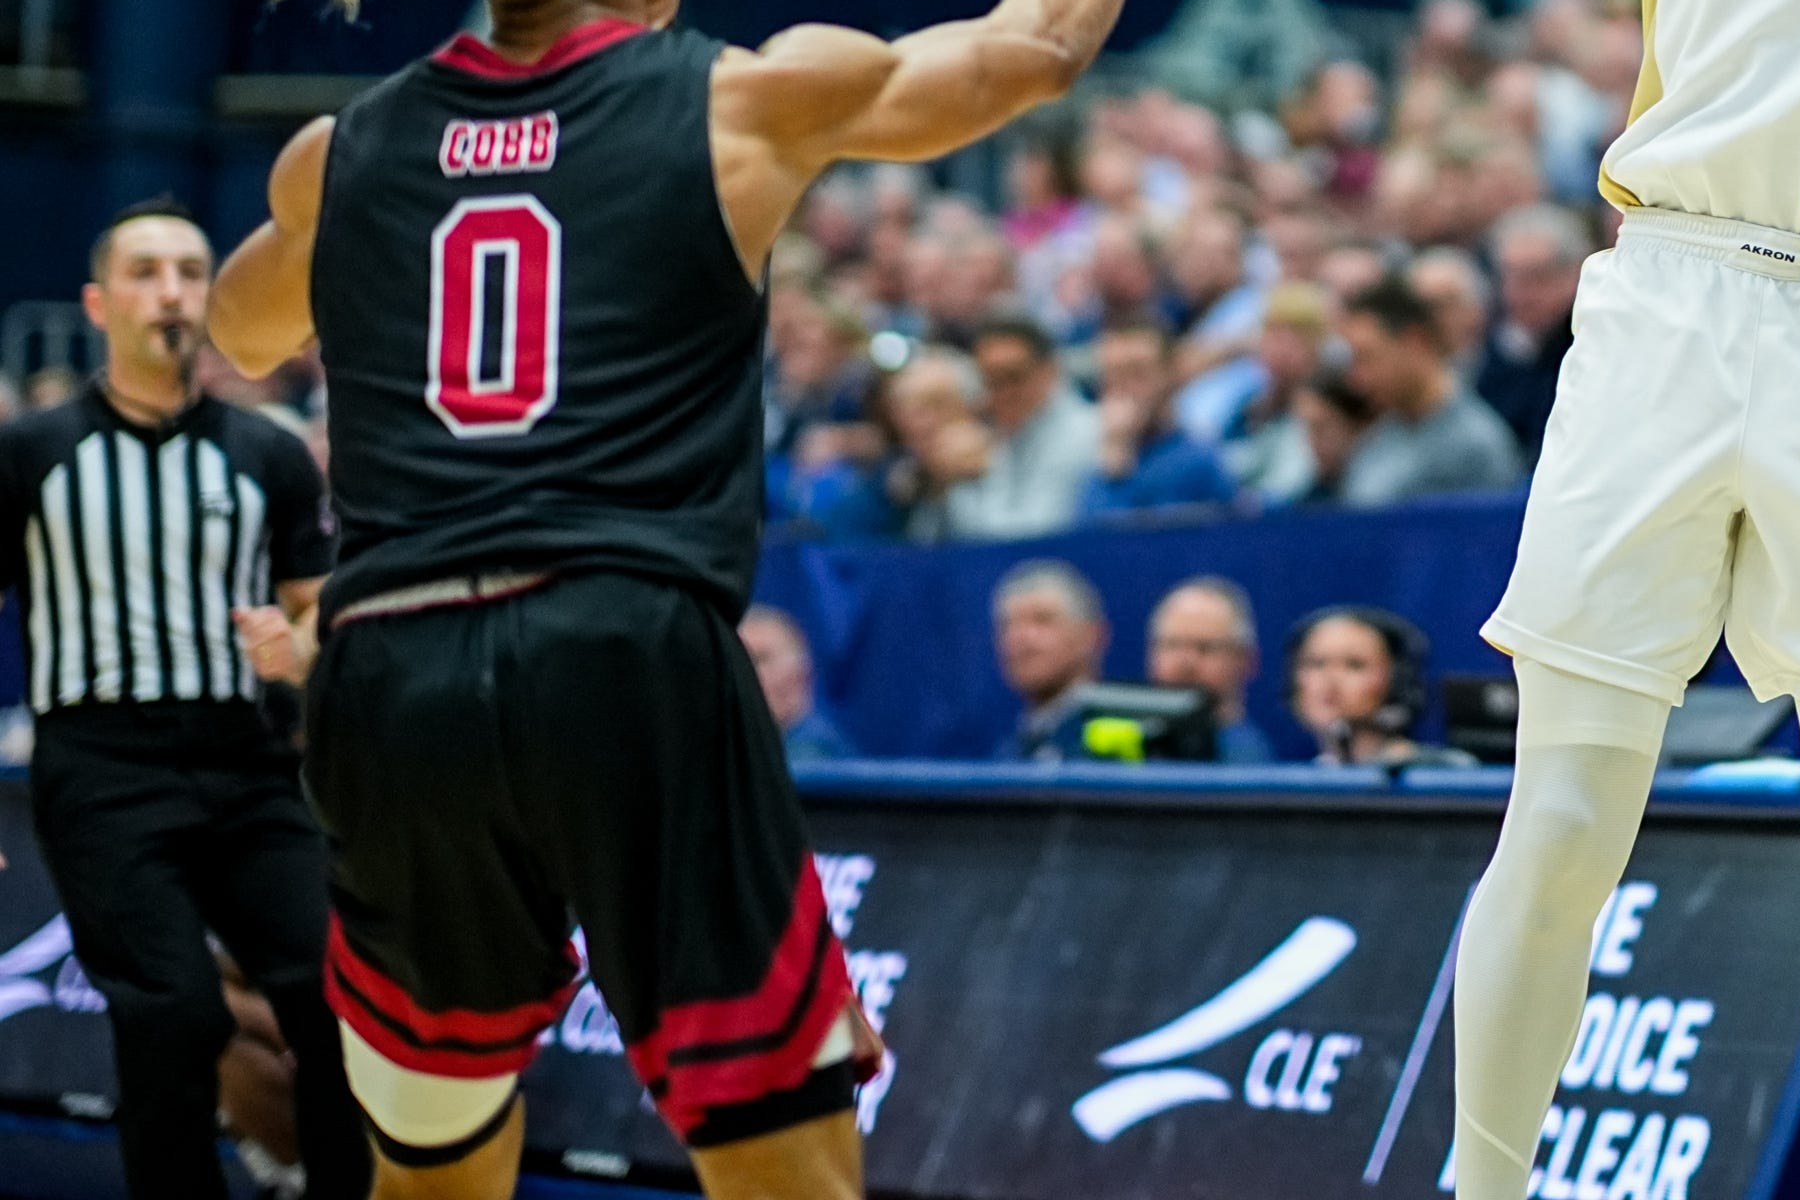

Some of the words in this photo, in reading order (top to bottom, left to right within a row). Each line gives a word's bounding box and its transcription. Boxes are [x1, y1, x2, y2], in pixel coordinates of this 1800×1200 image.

[439, 110, 559, 178] COBB
[1740, 243, 1796, 263] AKRON
[425, 194, 562, 440] 0
[1244, 1027, 1363, 1114] CLE
